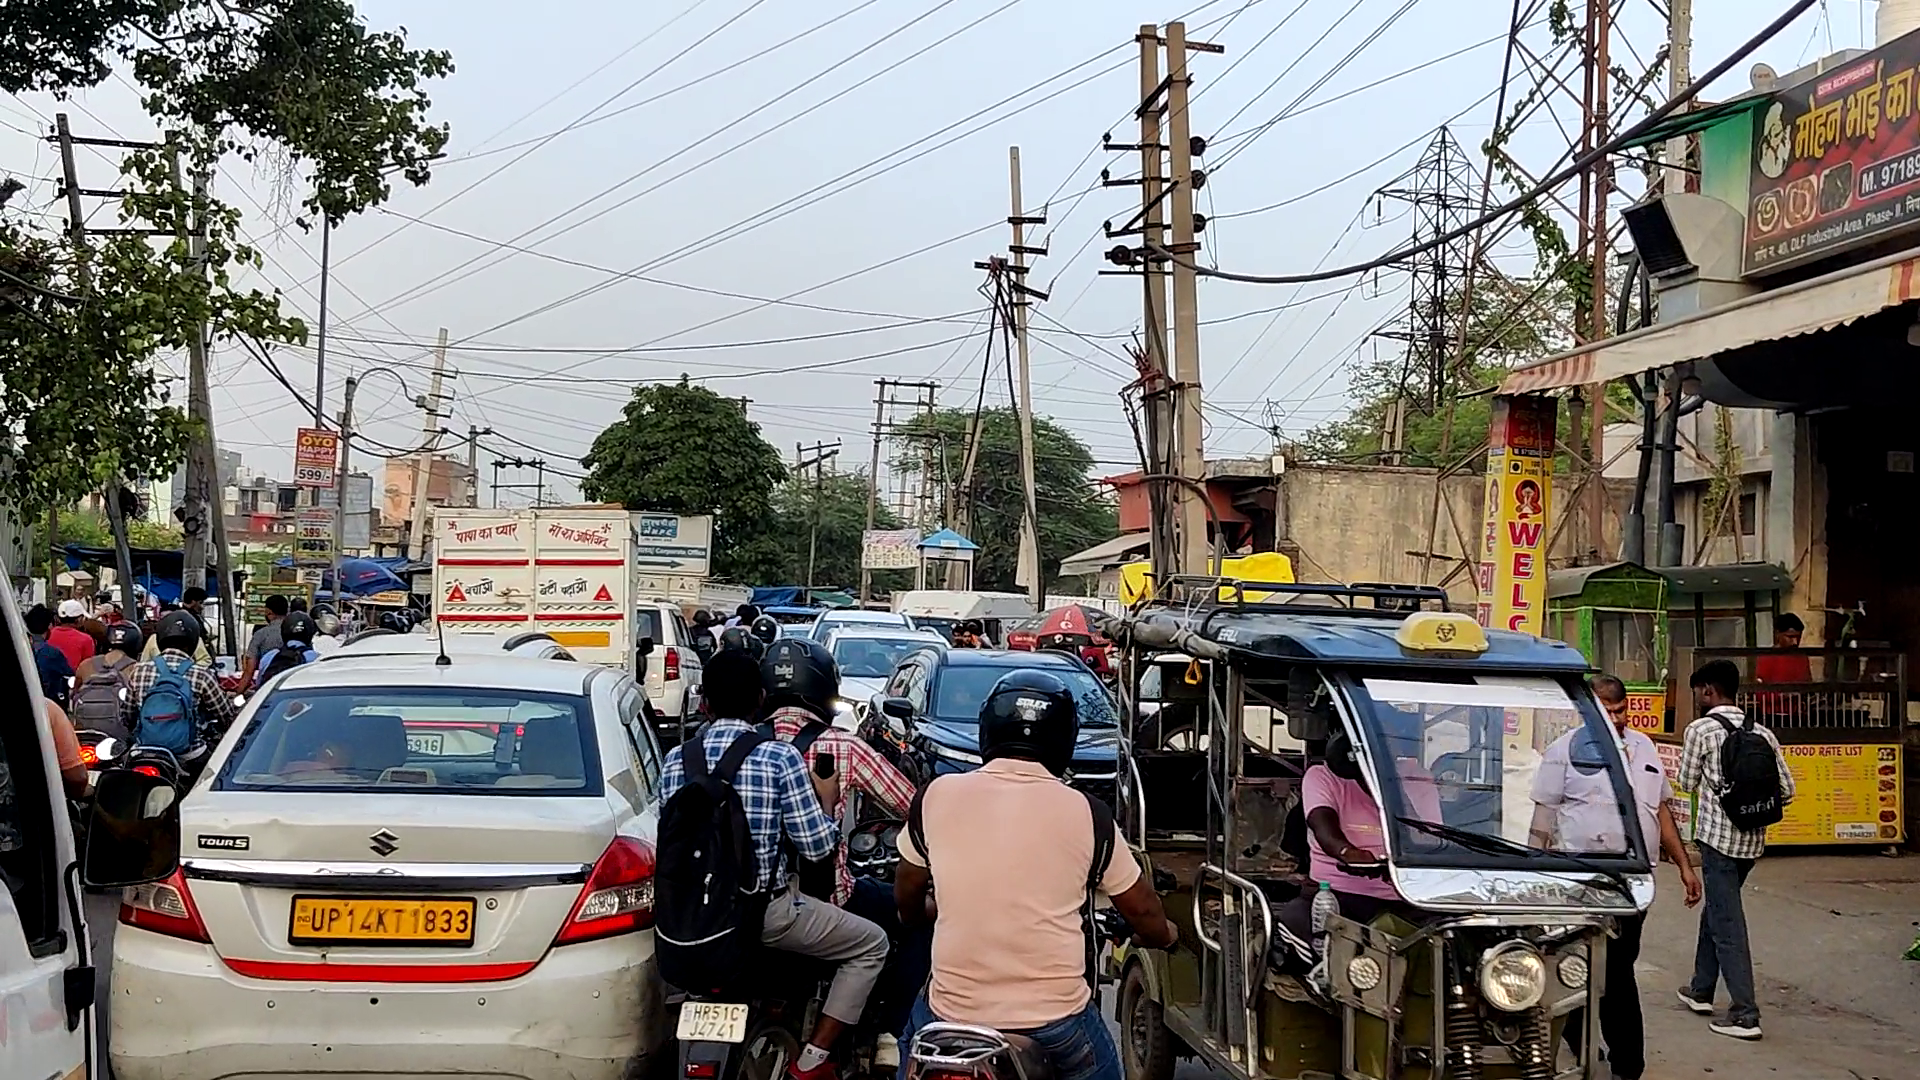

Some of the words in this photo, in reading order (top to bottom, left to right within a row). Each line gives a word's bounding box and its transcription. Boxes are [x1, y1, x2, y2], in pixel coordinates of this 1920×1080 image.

[1794, 93, 1844, 159] मोहन
[1846, 59, 1883, 140] भाई
[1886, 68, 1915, 122] का
[1862, 170, 1877, 194] M.
[1791, 234, 1806, 252] DLF
[1806, 222, 1842, 246] Industrial
[301, 436, 333, 447] OYO
[298, 445, 335, 456] HAPPY
[298, 468, 331, 481] 599/-
[479, 527, 493, 540] का
[495, 523, 519, 541] प्यार
[539, 579, 558, 597] बेटी
[1789, 746, 1816, 757] FOOD
[1818, 746, 1842, 757] RATE
[1845, 746, 1863, 756] LIST
[1740, 796, 1775, 815] safari
[200, 838, 234, 847] TOUR
[693, 1004, 740, 1021] HR51C
